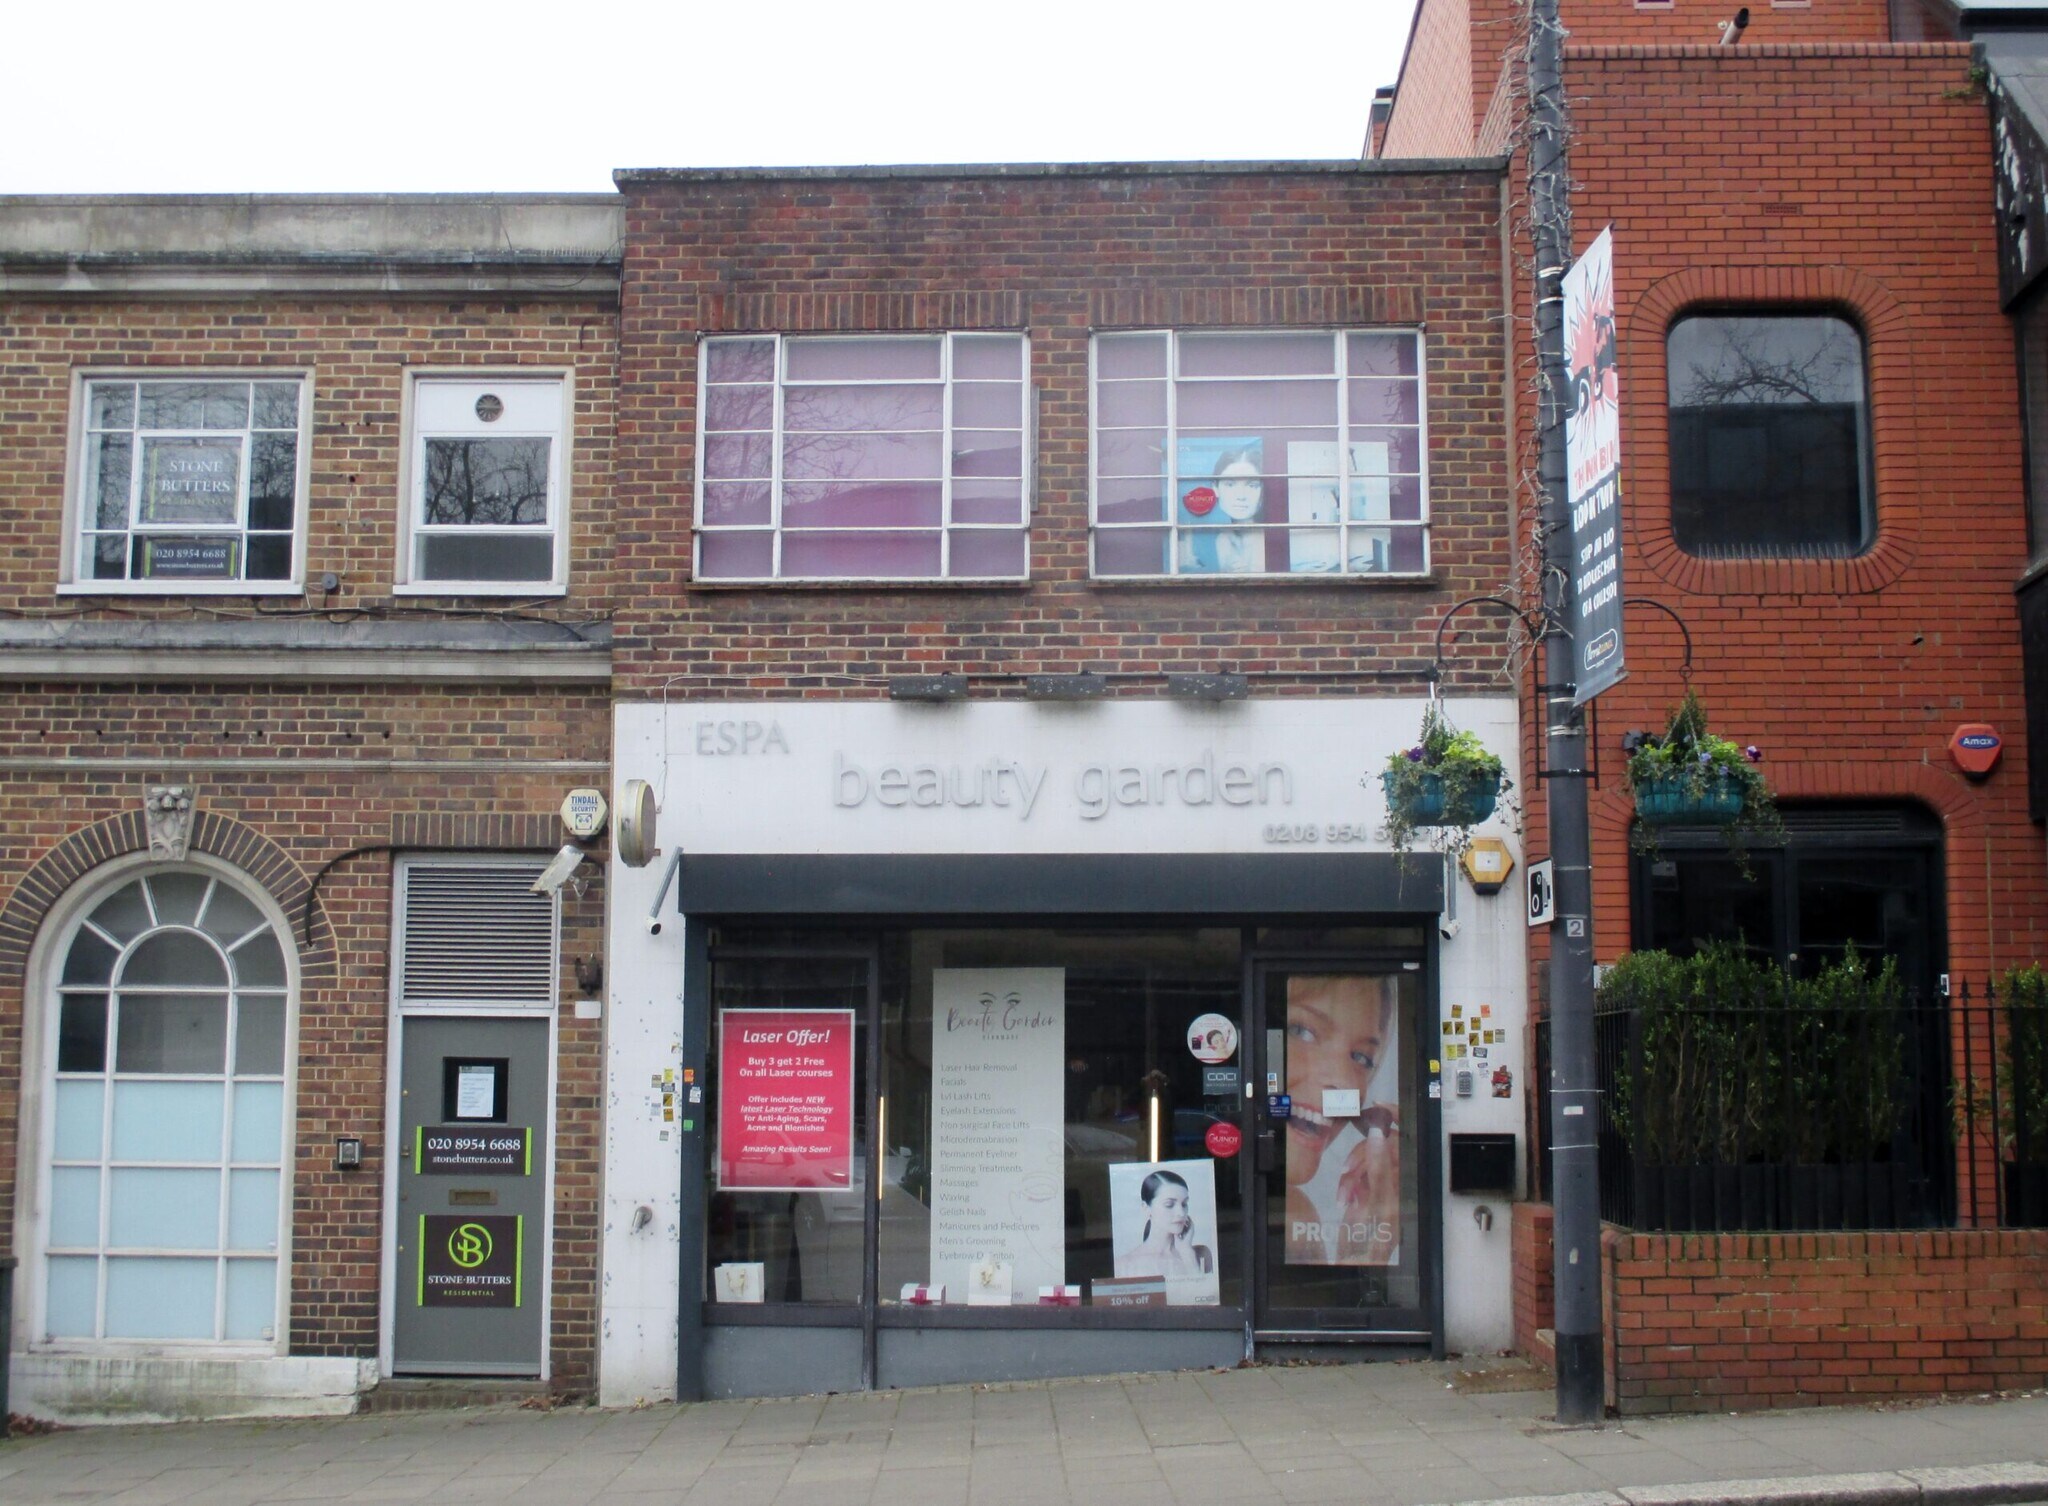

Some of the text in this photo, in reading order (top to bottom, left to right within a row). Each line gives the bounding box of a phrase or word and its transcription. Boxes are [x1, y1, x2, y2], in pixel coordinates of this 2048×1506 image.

[169, 461, 223, 472] STONE
[161, 480, 231, 492] BUTTERS
[156, 548, 227, 559] 020 8954 6688
[695, 720, 790, 757] ESPA
[833, 749, 1293, 821] beauty garden
[571, 796, 598, 804] TINDALL
[1263, 823, 1319, 844] 0208
[1325, 824, 1367, 843] 954
[1570, 920, 1582, 935] 2
[743, 1029, 831, 1046] Laser Offer!
[748, 1057, 825, 1067] Buy 3 get 2 Free
[740, 1068, 833, 1077] On all Laser courses
[940, 1064, 1018, 1072] Laser Hair Removal
[940, 1078, 967, 1086] Facials
[748, 1095, 768, 1103] Offer
[770, 1095, 803, 1103] includes
[954, 1092, 972, 1100] Lash
[974, 1092, 991, 1100] Lifts
[741, 1105, 834, 1114] latest Laser Technology
[940, 1107, 1016, 1116] Eyelash Extensions
[757, 1115, 801, 1123] Anti-Aging,
[803, 1115, 827, 1123] Scars,
[746, 1124, 825, 1132] Acne and Blemishes
[940, 1121, 1030, 1130] Non surgical Face Lifts
[940, 1136, 1018, 1144] Microdermabrasion
[1209, 1132, 1238, 1143] GUINOT
[428, 1138, 521, 1151] 020 8954 6688
[742, 1145, 832, 1154] Amazing Results Seen!
[432, 1153, 514, 1164] stonebutters.co.uk
[940, 1150, 1017, 1159] Permanent Eyeliner
[940, 1165, 1023, 1174] Slimming Treatments
[940, 1179, 978, 1188] Massages
[940, 1194, 969, 1202] Waxing
[939, 1208, 986, 1216] Gelish Nails
[940, 1222, 1040, 1231] Manicures and Pedicures
[939, 1237, 1006, 1247] Men's Grooming
[939, 1252, 974, 1261] Eyebrow
[1111, 1295, 1150, 1306] 10% off
